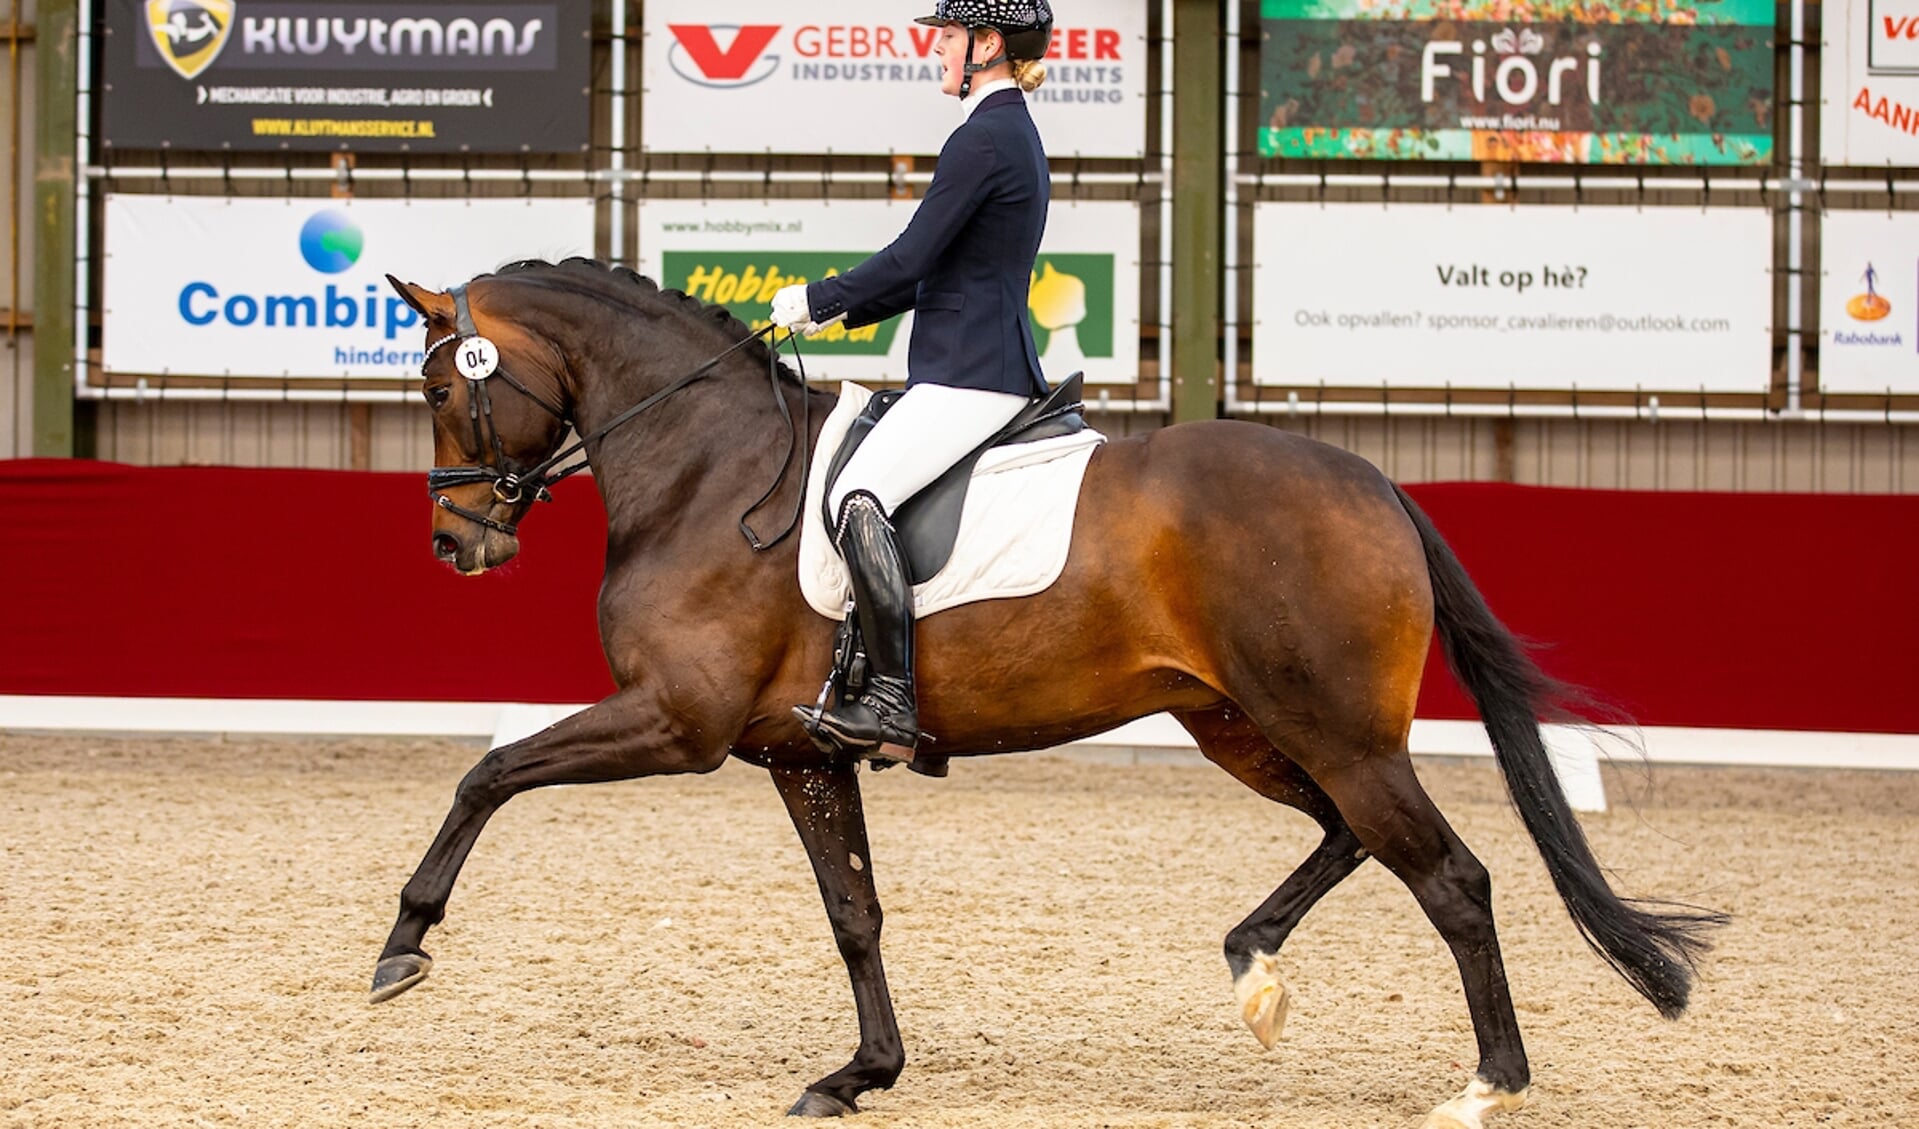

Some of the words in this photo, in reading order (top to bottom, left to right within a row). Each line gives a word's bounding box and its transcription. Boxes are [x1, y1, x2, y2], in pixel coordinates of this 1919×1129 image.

[1421, 39, 1602, 105] Fiori
[293, 87, 325, 104] VOOR
[391, 88, 424, 105] AGRO
[442, 89, 481, 106] GROEN
[1460, 112, 1561, 131] www.fiori.nu
[662, 219, 803, 235] www.hobbymix.nl
[686, 265, 807, 304] Hobb
[1436, 264, 1490, 287] Valt
[1498, 270, 1534, 293] op
[1543, 264, 1588, 288] hè?
[178, 282, 418, 339] Combip
[1294, 309, 1331, 327] Ook
[1336, 311, 1421, 332] opvallen?
[1427, 312, 1731, 335] sponsor_cavalieren@outlook.com
[1833, 330, 1902, 345] Rabobank
[335, 346, 424, 365] hindern
[466, 348, 488, 368] 04
